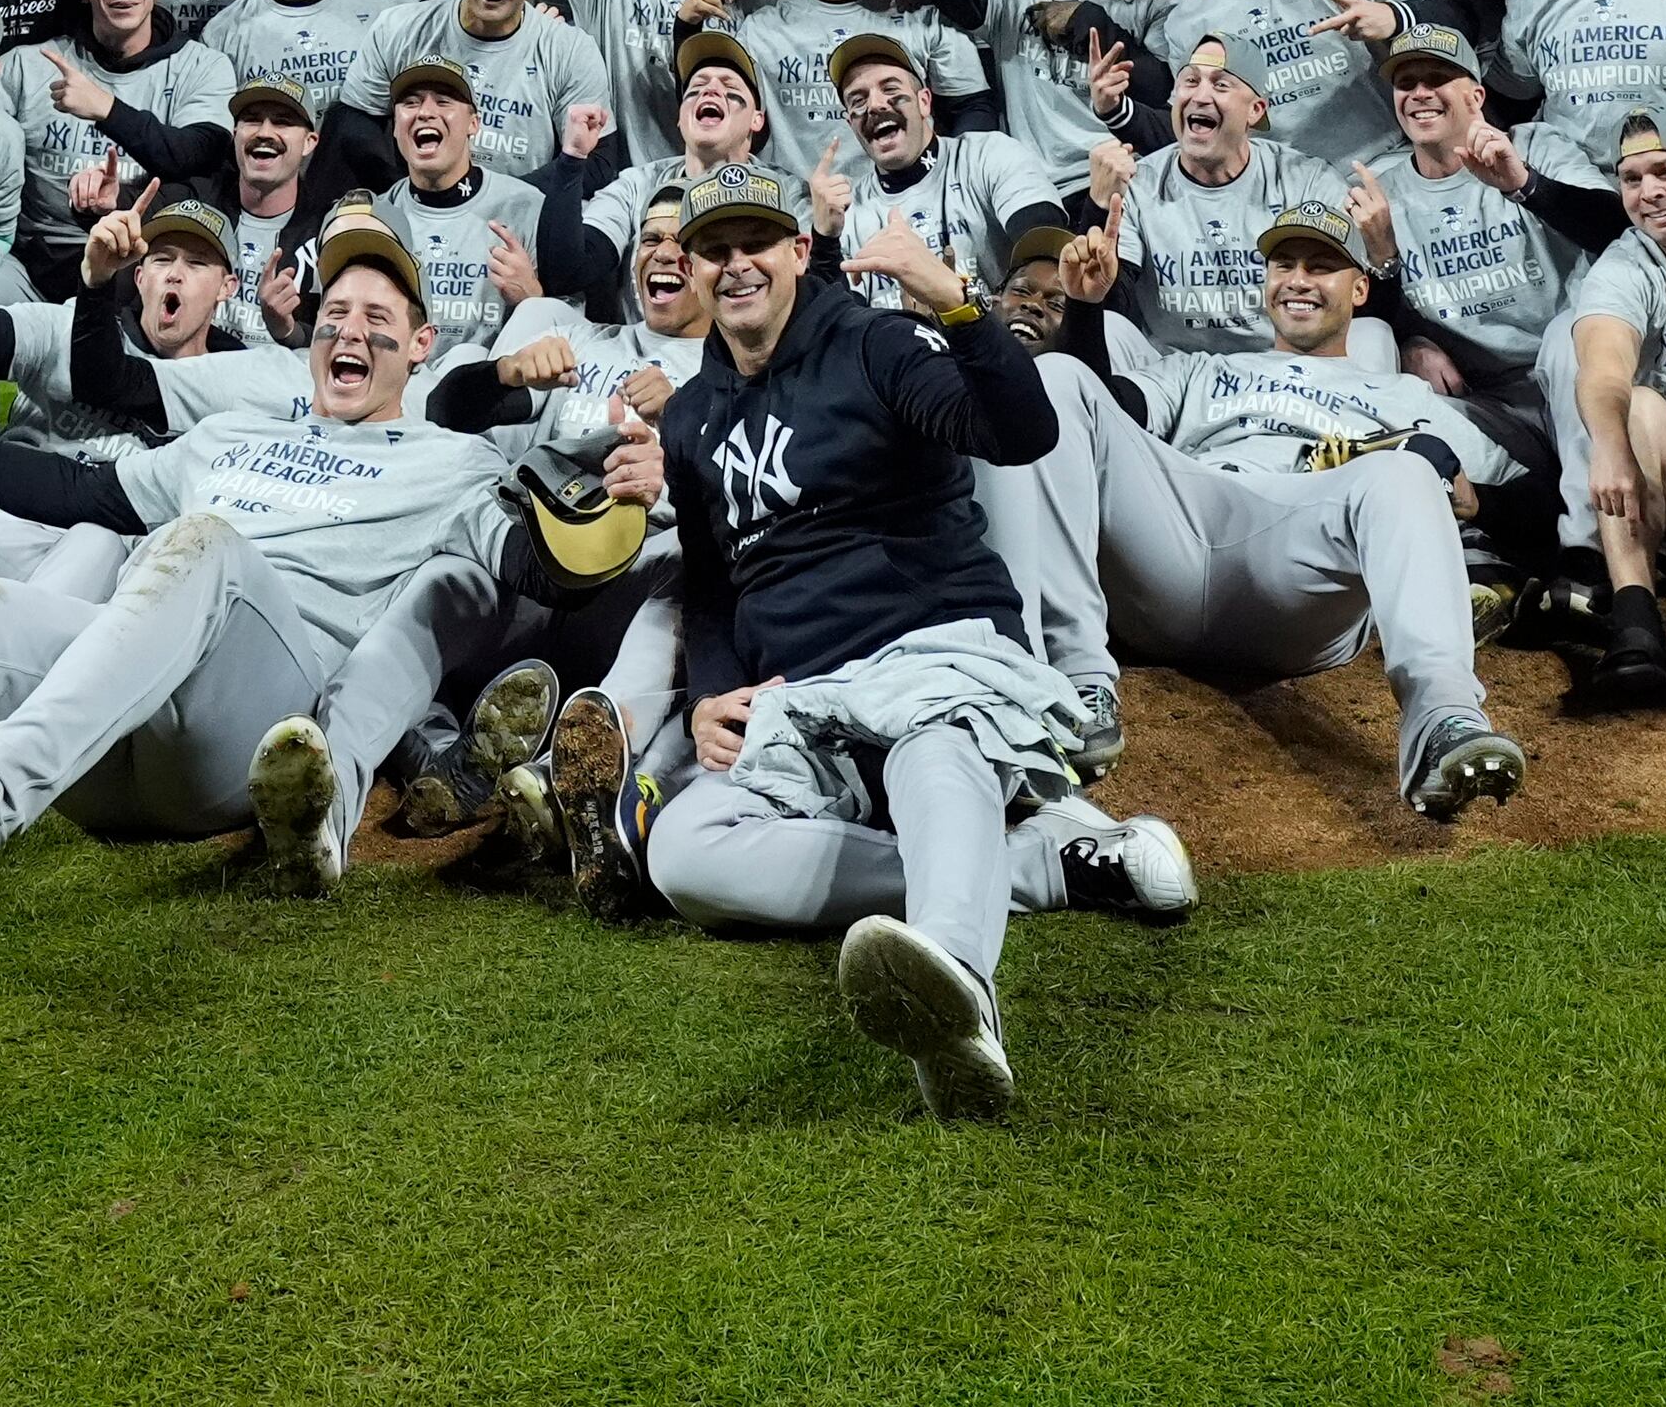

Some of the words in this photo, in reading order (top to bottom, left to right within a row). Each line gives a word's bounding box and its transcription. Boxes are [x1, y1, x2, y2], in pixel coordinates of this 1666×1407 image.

[279, 50, 358, 72] AMERICA
[1571, 43, 1648, 64] LEAGUE
[1429, 217, 1529, 259] AMERICAN
[1189, 248, 1267, 268] AMERIC
[1433, 246, 1506, 278] LEAGUE
[1190, 268, 1266, 287] LEAGUE
[248, 457, 340, 487] LEAGUE
[263, 441, 385, 480] AMERICAN
[194, 471, 359, 516] CHAMPIONS
